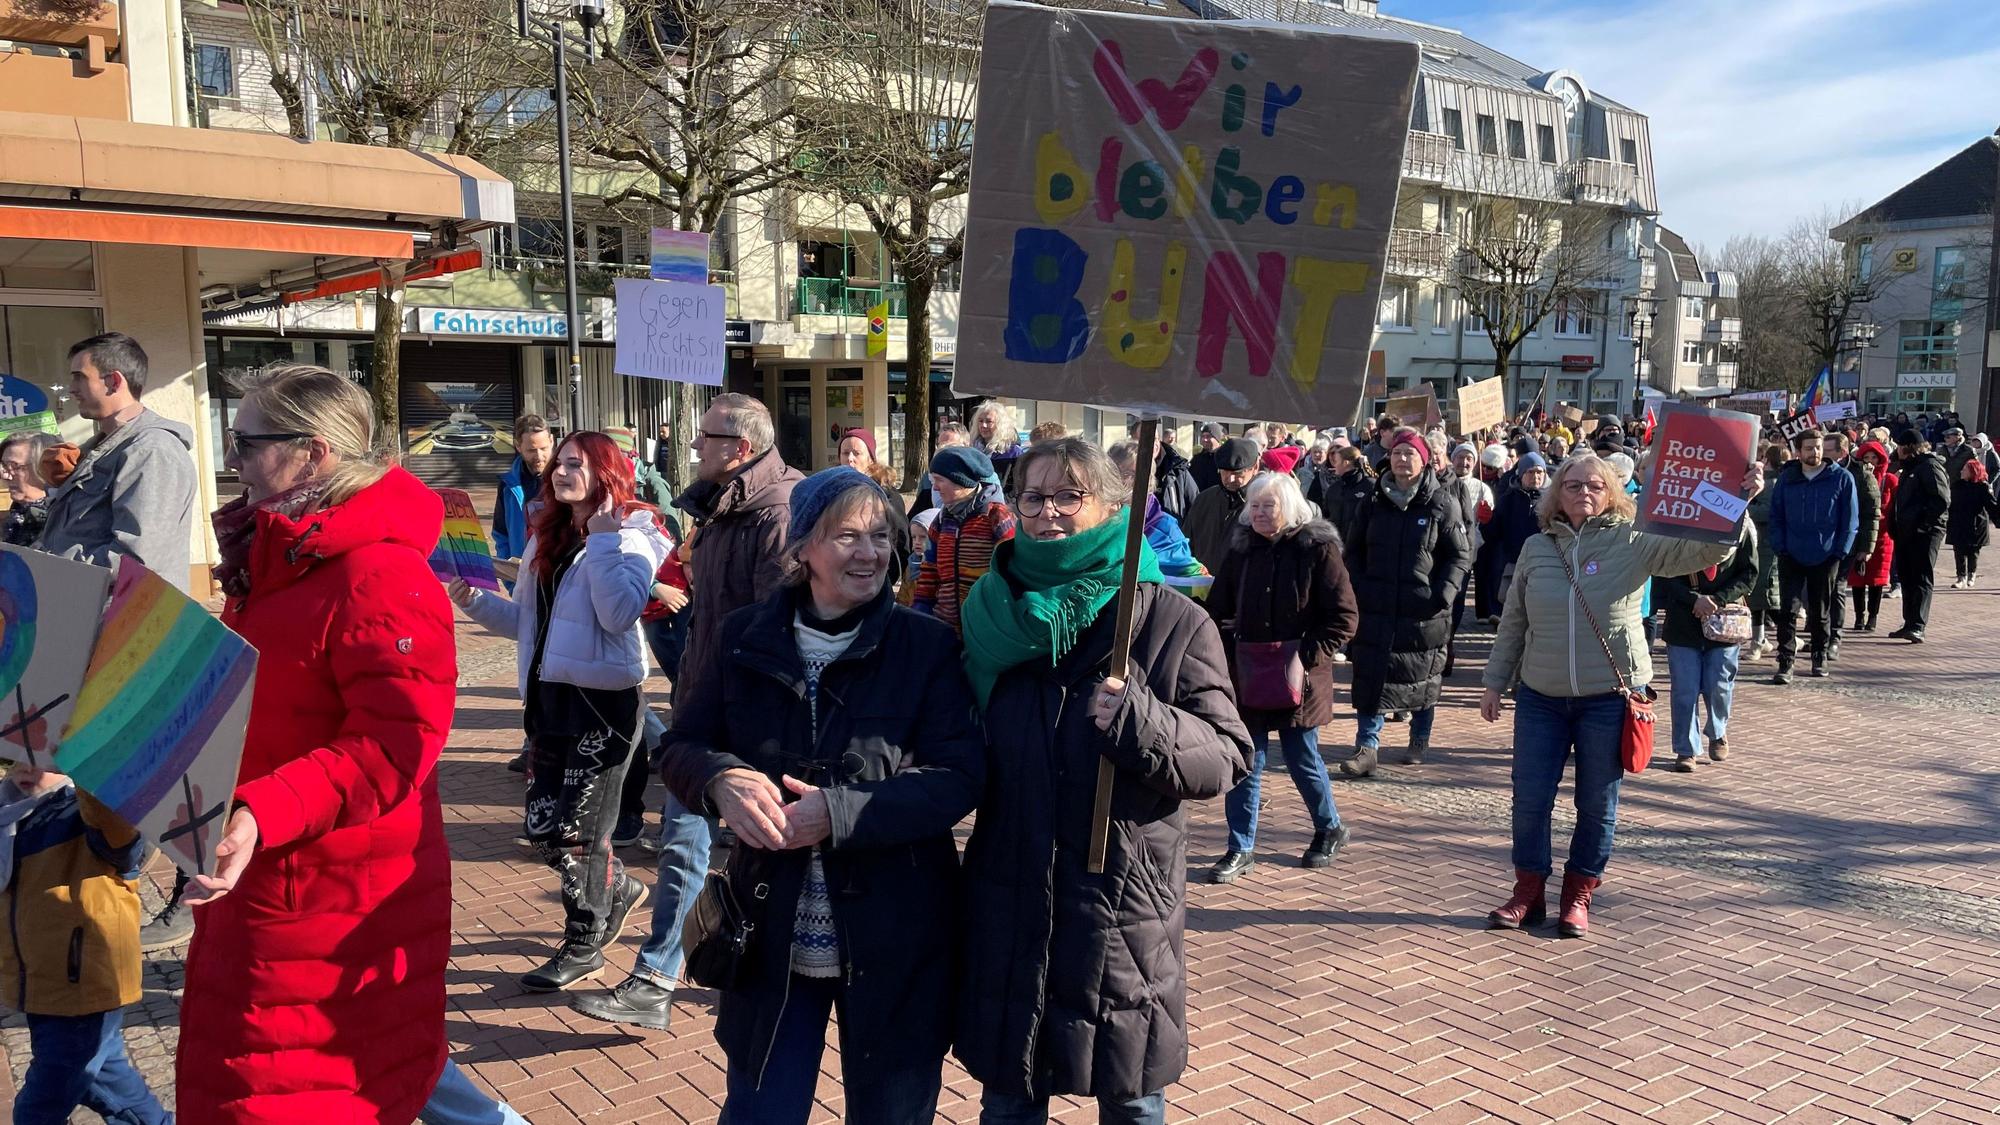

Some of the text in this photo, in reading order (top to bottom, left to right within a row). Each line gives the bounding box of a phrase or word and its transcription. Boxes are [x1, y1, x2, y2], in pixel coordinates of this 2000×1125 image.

[1093, 39, 1302, 137] Wir
[1034, 129, 1358, 230] bleiben
[640, 285, 707, 329] Gegen
[1003, 228, 1374, 387] BUNT
[433, 311, 568, 336] Fahrschule
[725, 329, 744, 337] enter
[1902, 375, 1952, 385] MARIE
[1666, 439, 1716, 462] Rote
[1661, 459, 1723, 483] Karte
[1657, 478, 1692, 499] für
[1652, 499, 1702, 520] AfD!
